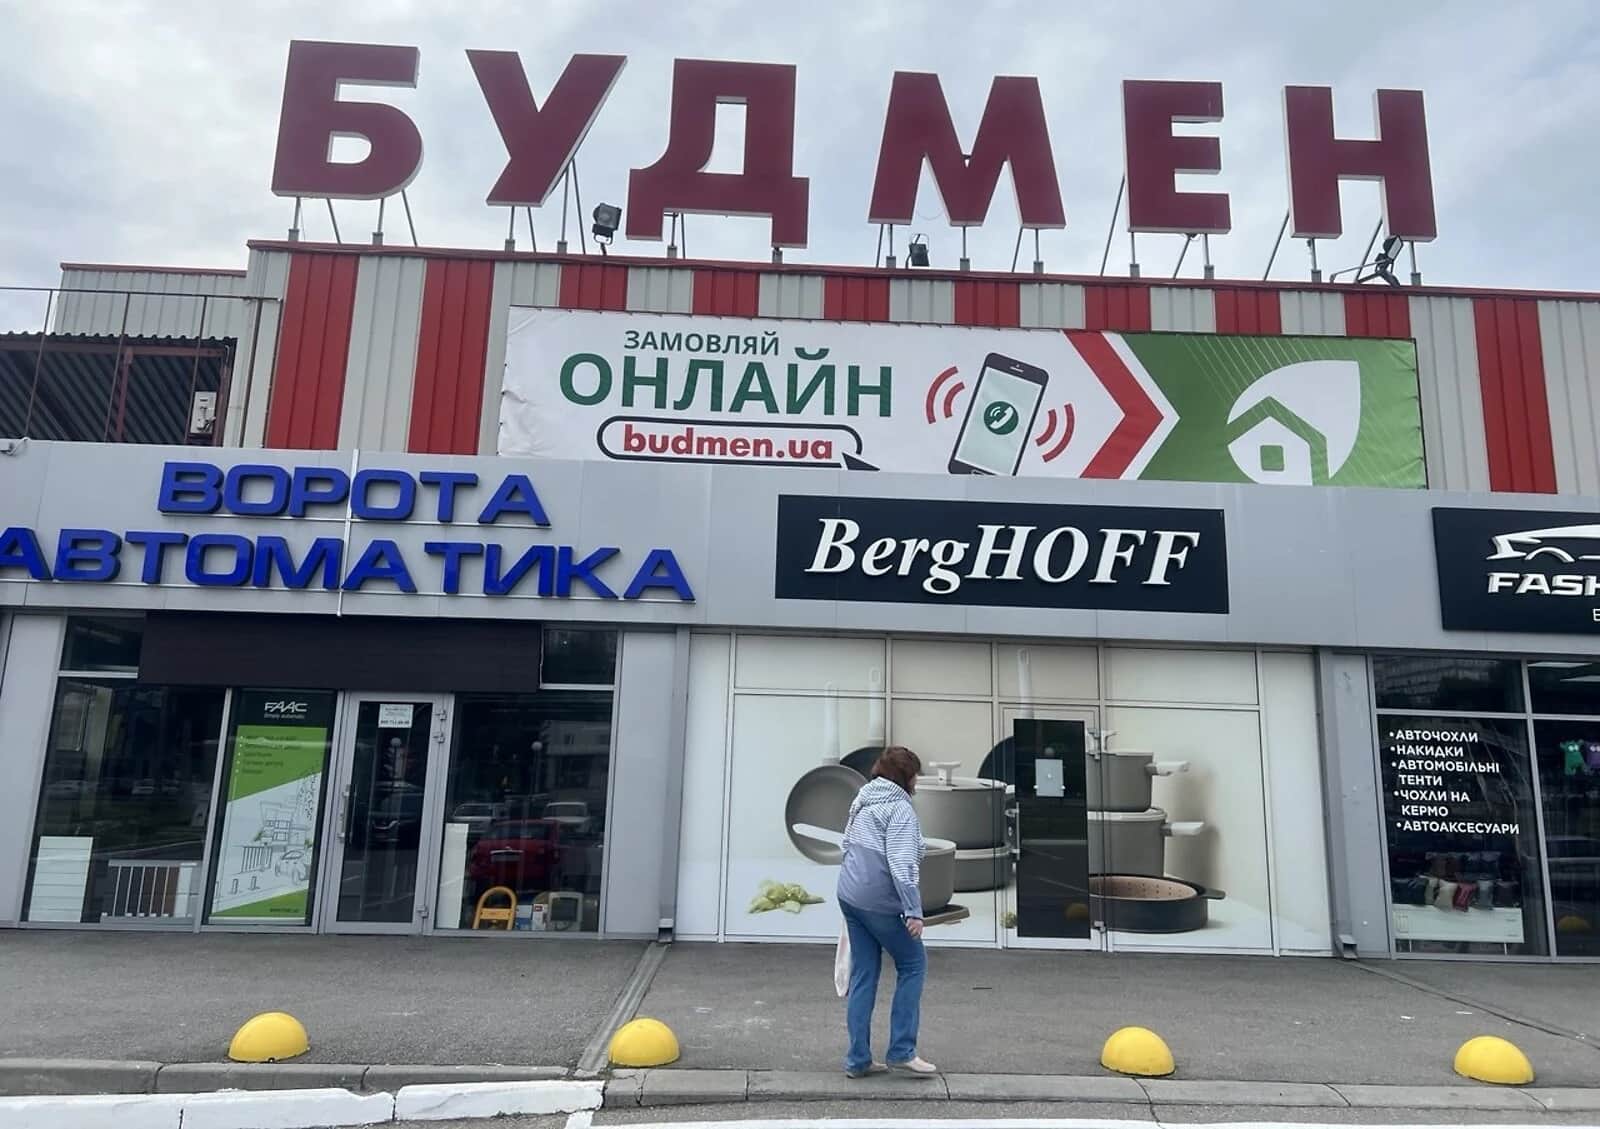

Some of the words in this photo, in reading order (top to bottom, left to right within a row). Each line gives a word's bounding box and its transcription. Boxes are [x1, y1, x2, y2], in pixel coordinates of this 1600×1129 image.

[271, 39, 1438, 250] БУДМЕН
[623, 329, 780, 357] ЗАМОВЛЯЙ
[559, 346, 893, 418] ОНЛАЙН
[623, 424, 834, 460] budmen.ua
[157, 461, 552, 527] ВОРОТА
[804, 517, 1201, 595] BergHOFF
[0, 526, 697, 602] АВТОМАТИКА
[264, 700, 309, 713] FAAC
[1395, 729, 1479, 744] АВТОЧОХЛИ
[1396, 744, 1465, 758] НАКИДКИ
[1398, 759, 1500, 774] АВТОМОБІЛЬНІ
[1398, 774, 1443, 787] ТЕНТИ
[1400, 789, 1447, 802] ЧОХЛИ
[1451, 791, 1471, 803] НА
[1401, 804, 1449, 818] КЕРМО
[1403, 820, 1520, 835] АВТОАКСЕСУАРИ
